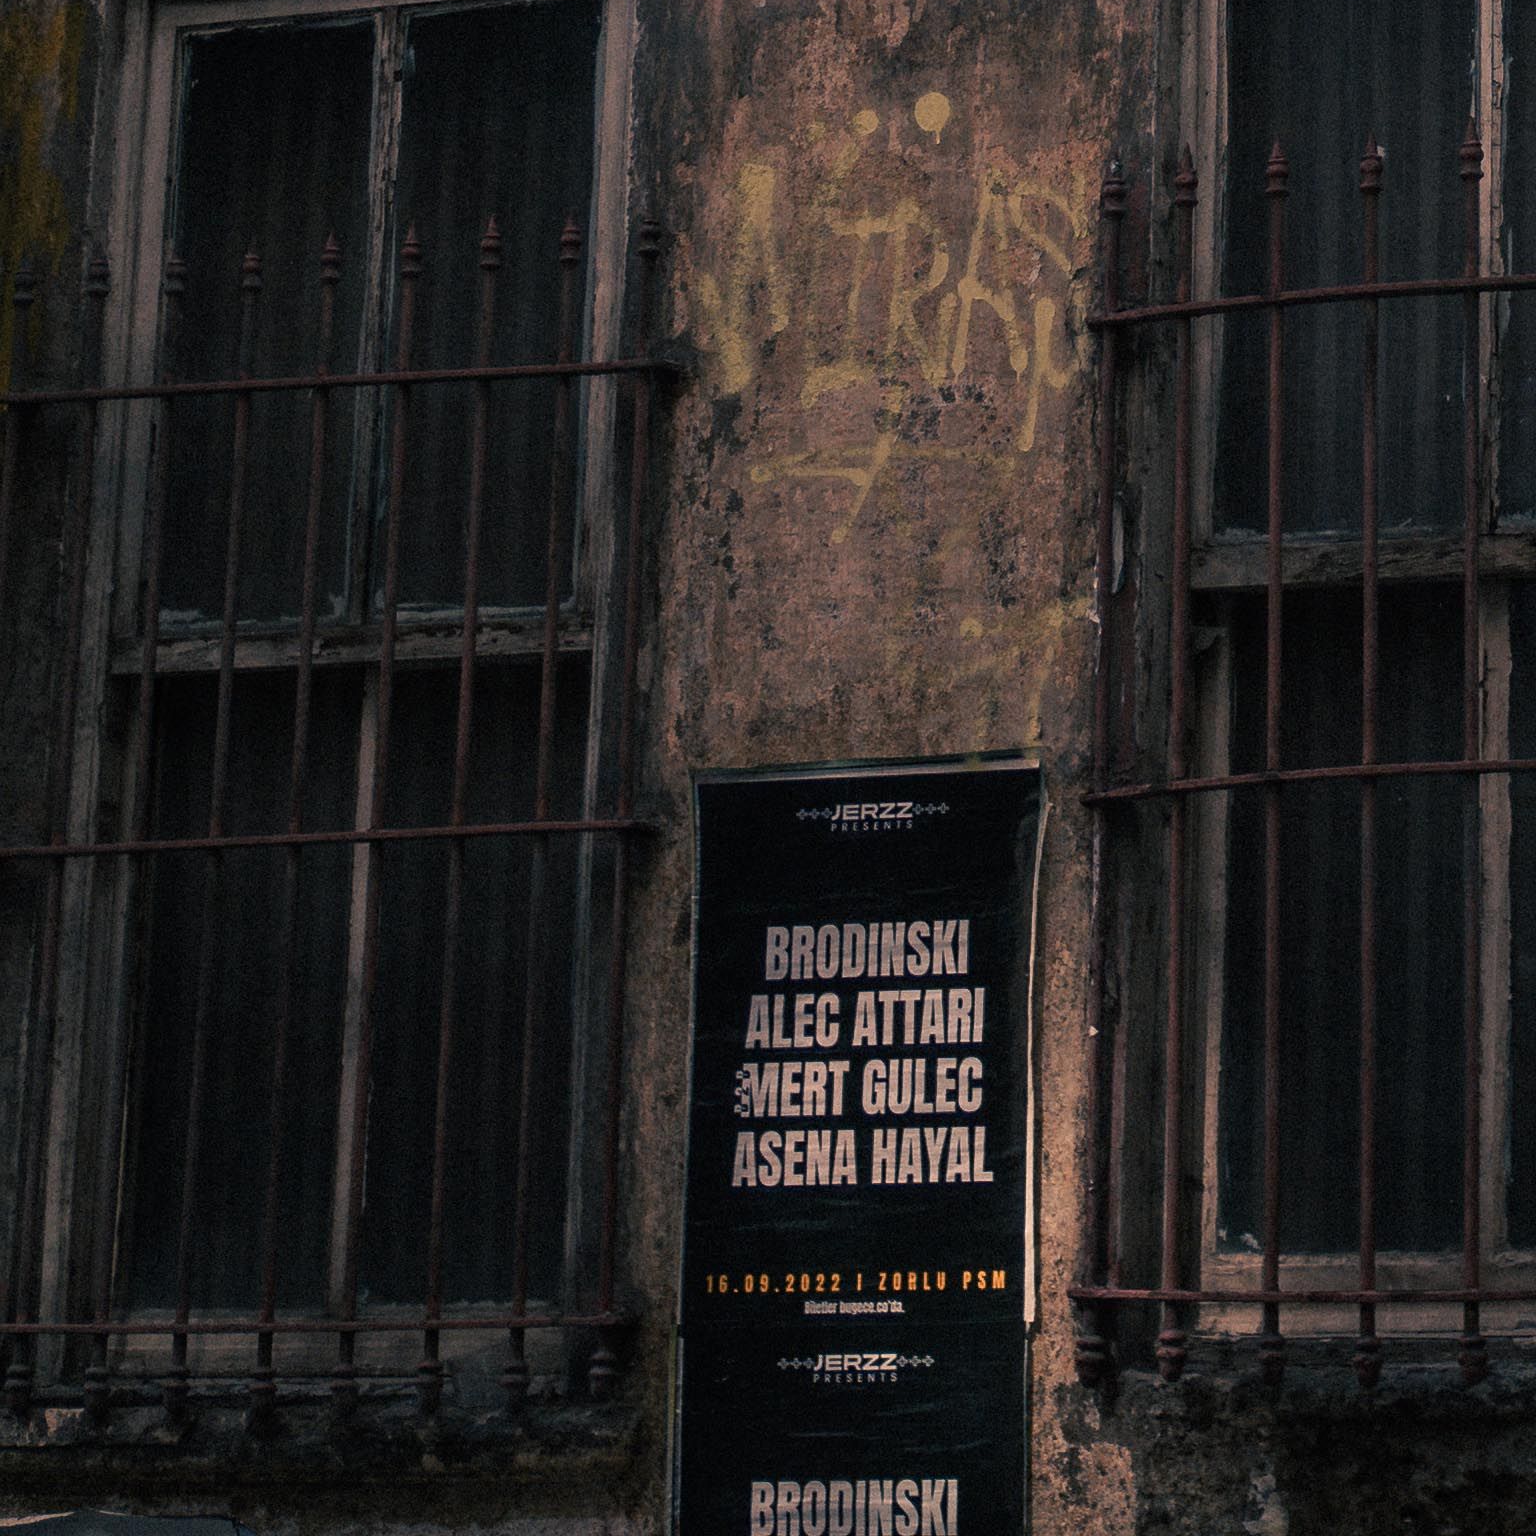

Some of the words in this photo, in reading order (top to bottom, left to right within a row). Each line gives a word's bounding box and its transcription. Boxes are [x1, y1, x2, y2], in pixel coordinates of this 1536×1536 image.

[830, 801, 914, 822] JERZZ
[830, 819, 913, 832] PRESENTS
[764, 919, 970, 982] BRODINSKI
[744, 991, 841, 1050] ALEC
[851, 986, 986, 1047] ATTARI
[742, 1059, 850, 1119] MERT
[861, 1055, 984, 1116] GULEC
[730, 1129, 858, 1188] ASENA
[870, 1125, 995, 1185] HAYAL
[705, 1272, 841, 1294] 16.09.2022
[878, 1271, 947, 1292] ZORLU
[961, 1269, 1007, 1291] PSM
[812, 1371, 899, 1384] PRESENTS
[813, 1353, 898, 1372] JERZZ
[749, 1479, 959, 1536] BRODINSKI
